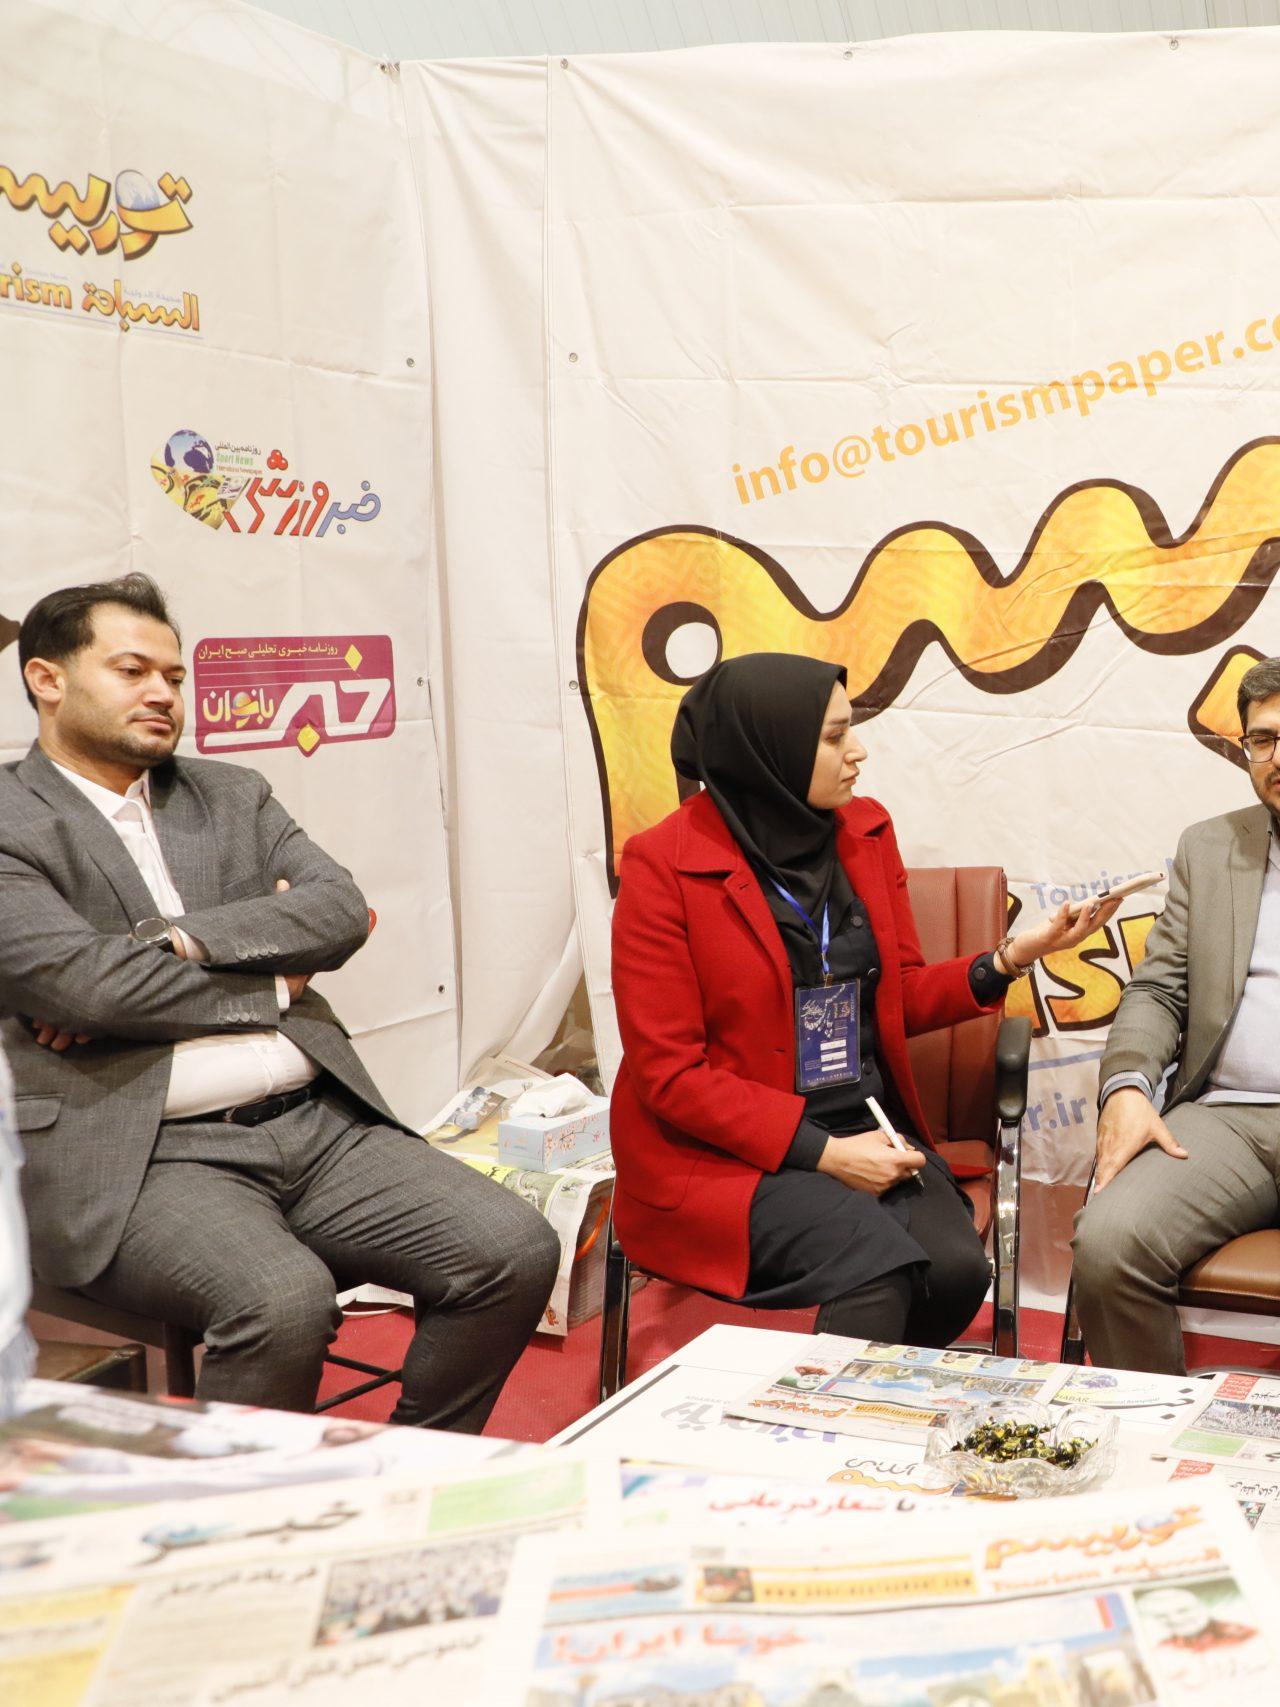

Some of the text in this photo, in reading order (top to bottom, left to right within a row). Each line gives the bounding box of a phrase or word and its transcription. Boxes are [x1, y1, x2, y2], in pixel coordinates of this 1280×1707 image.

[0, 165, 193, 261] توریس
[0, 262, 72, 309] rism
[199, 642, 338, 660] روزنامه خبری تحلیلی صبح ایران
[1030, 869, 1157, 910] Touri
